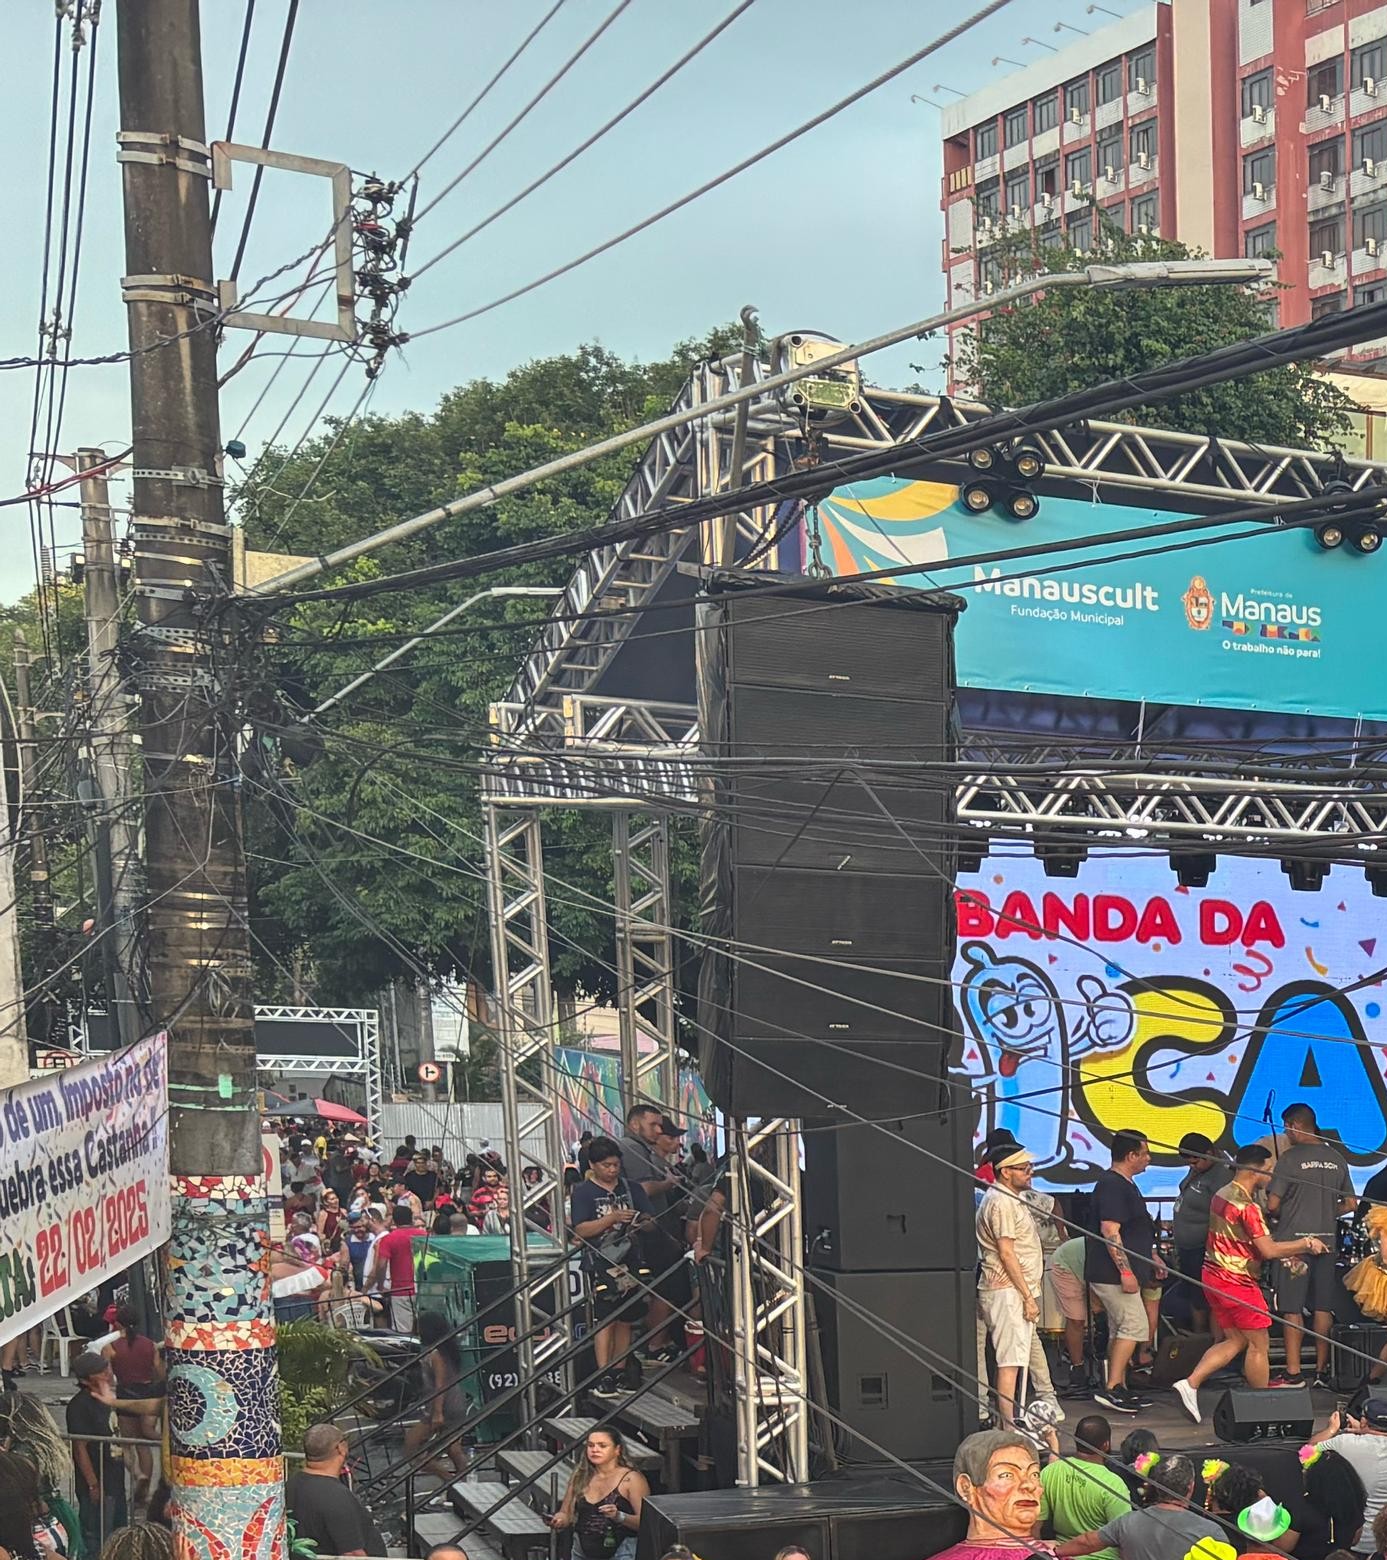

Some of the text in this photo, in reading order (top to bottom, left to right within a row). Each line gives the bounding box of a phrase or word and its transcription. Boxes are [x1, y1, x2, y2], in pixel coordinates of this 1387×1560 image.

[974, 564, 1160, 611] Manauscult
[1011, 604, 1125, 627] Fundação Municipal
[1221, 592, 1322, 627] Manaus
[1222, 639, 1321, 659] O trabalho não para!
[955, 889, 1285, 948] BANDA DA
[0, 1160, 47, 1220] uebra
[49, 1149, 85, 1196] essa
[36, 1180, 149, 1298] 22/02/2025
[488, 1372, 519, 1389] (92)
